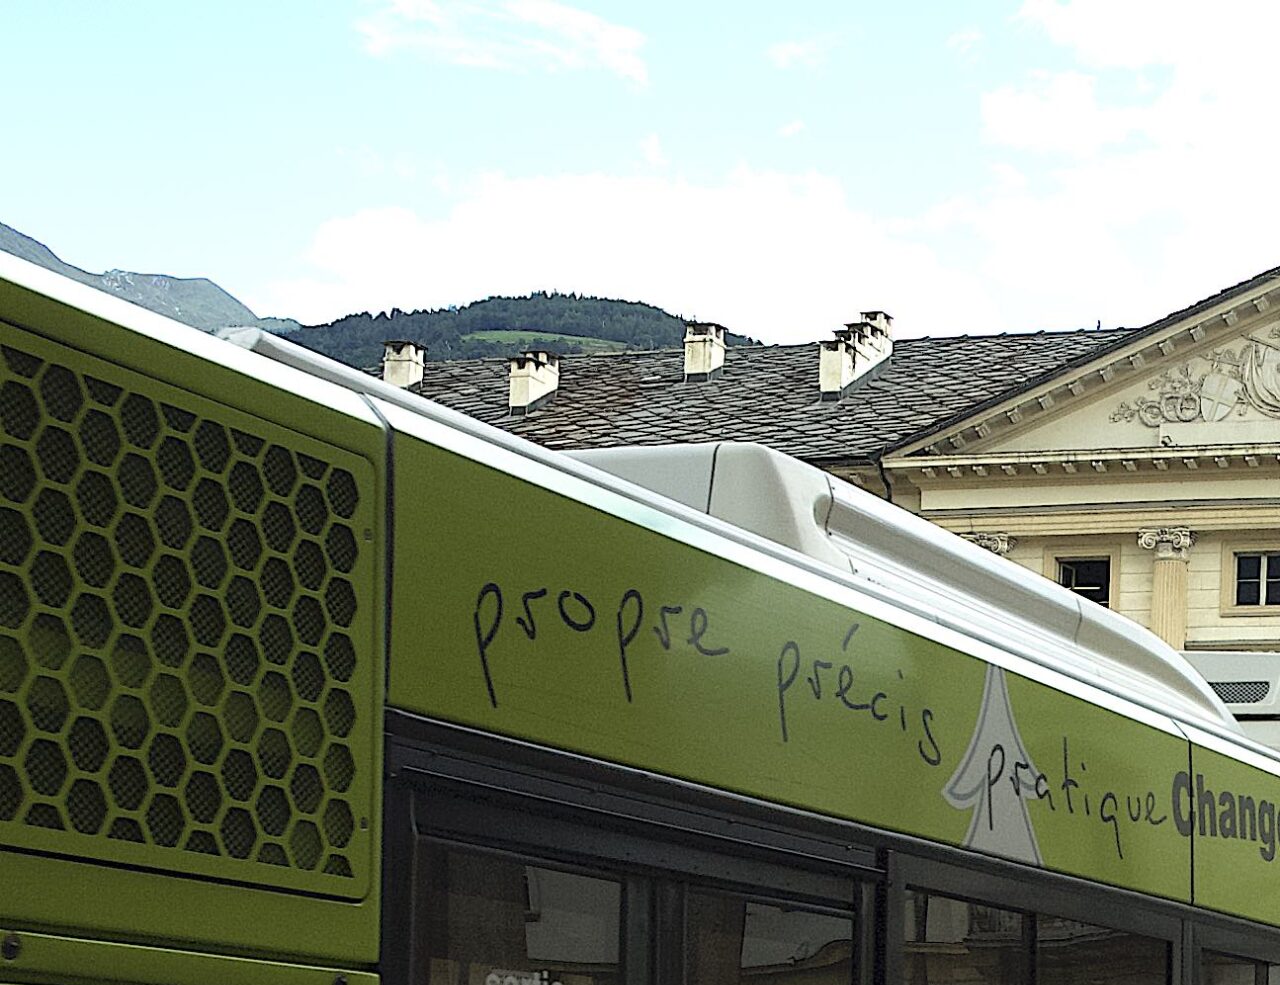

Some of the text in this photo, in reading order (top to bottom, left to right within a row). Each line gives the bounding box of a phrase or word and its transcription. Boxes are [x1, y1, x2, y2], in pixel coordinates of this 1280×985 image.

[473, 582, 1166, 860] propre précis pratique
